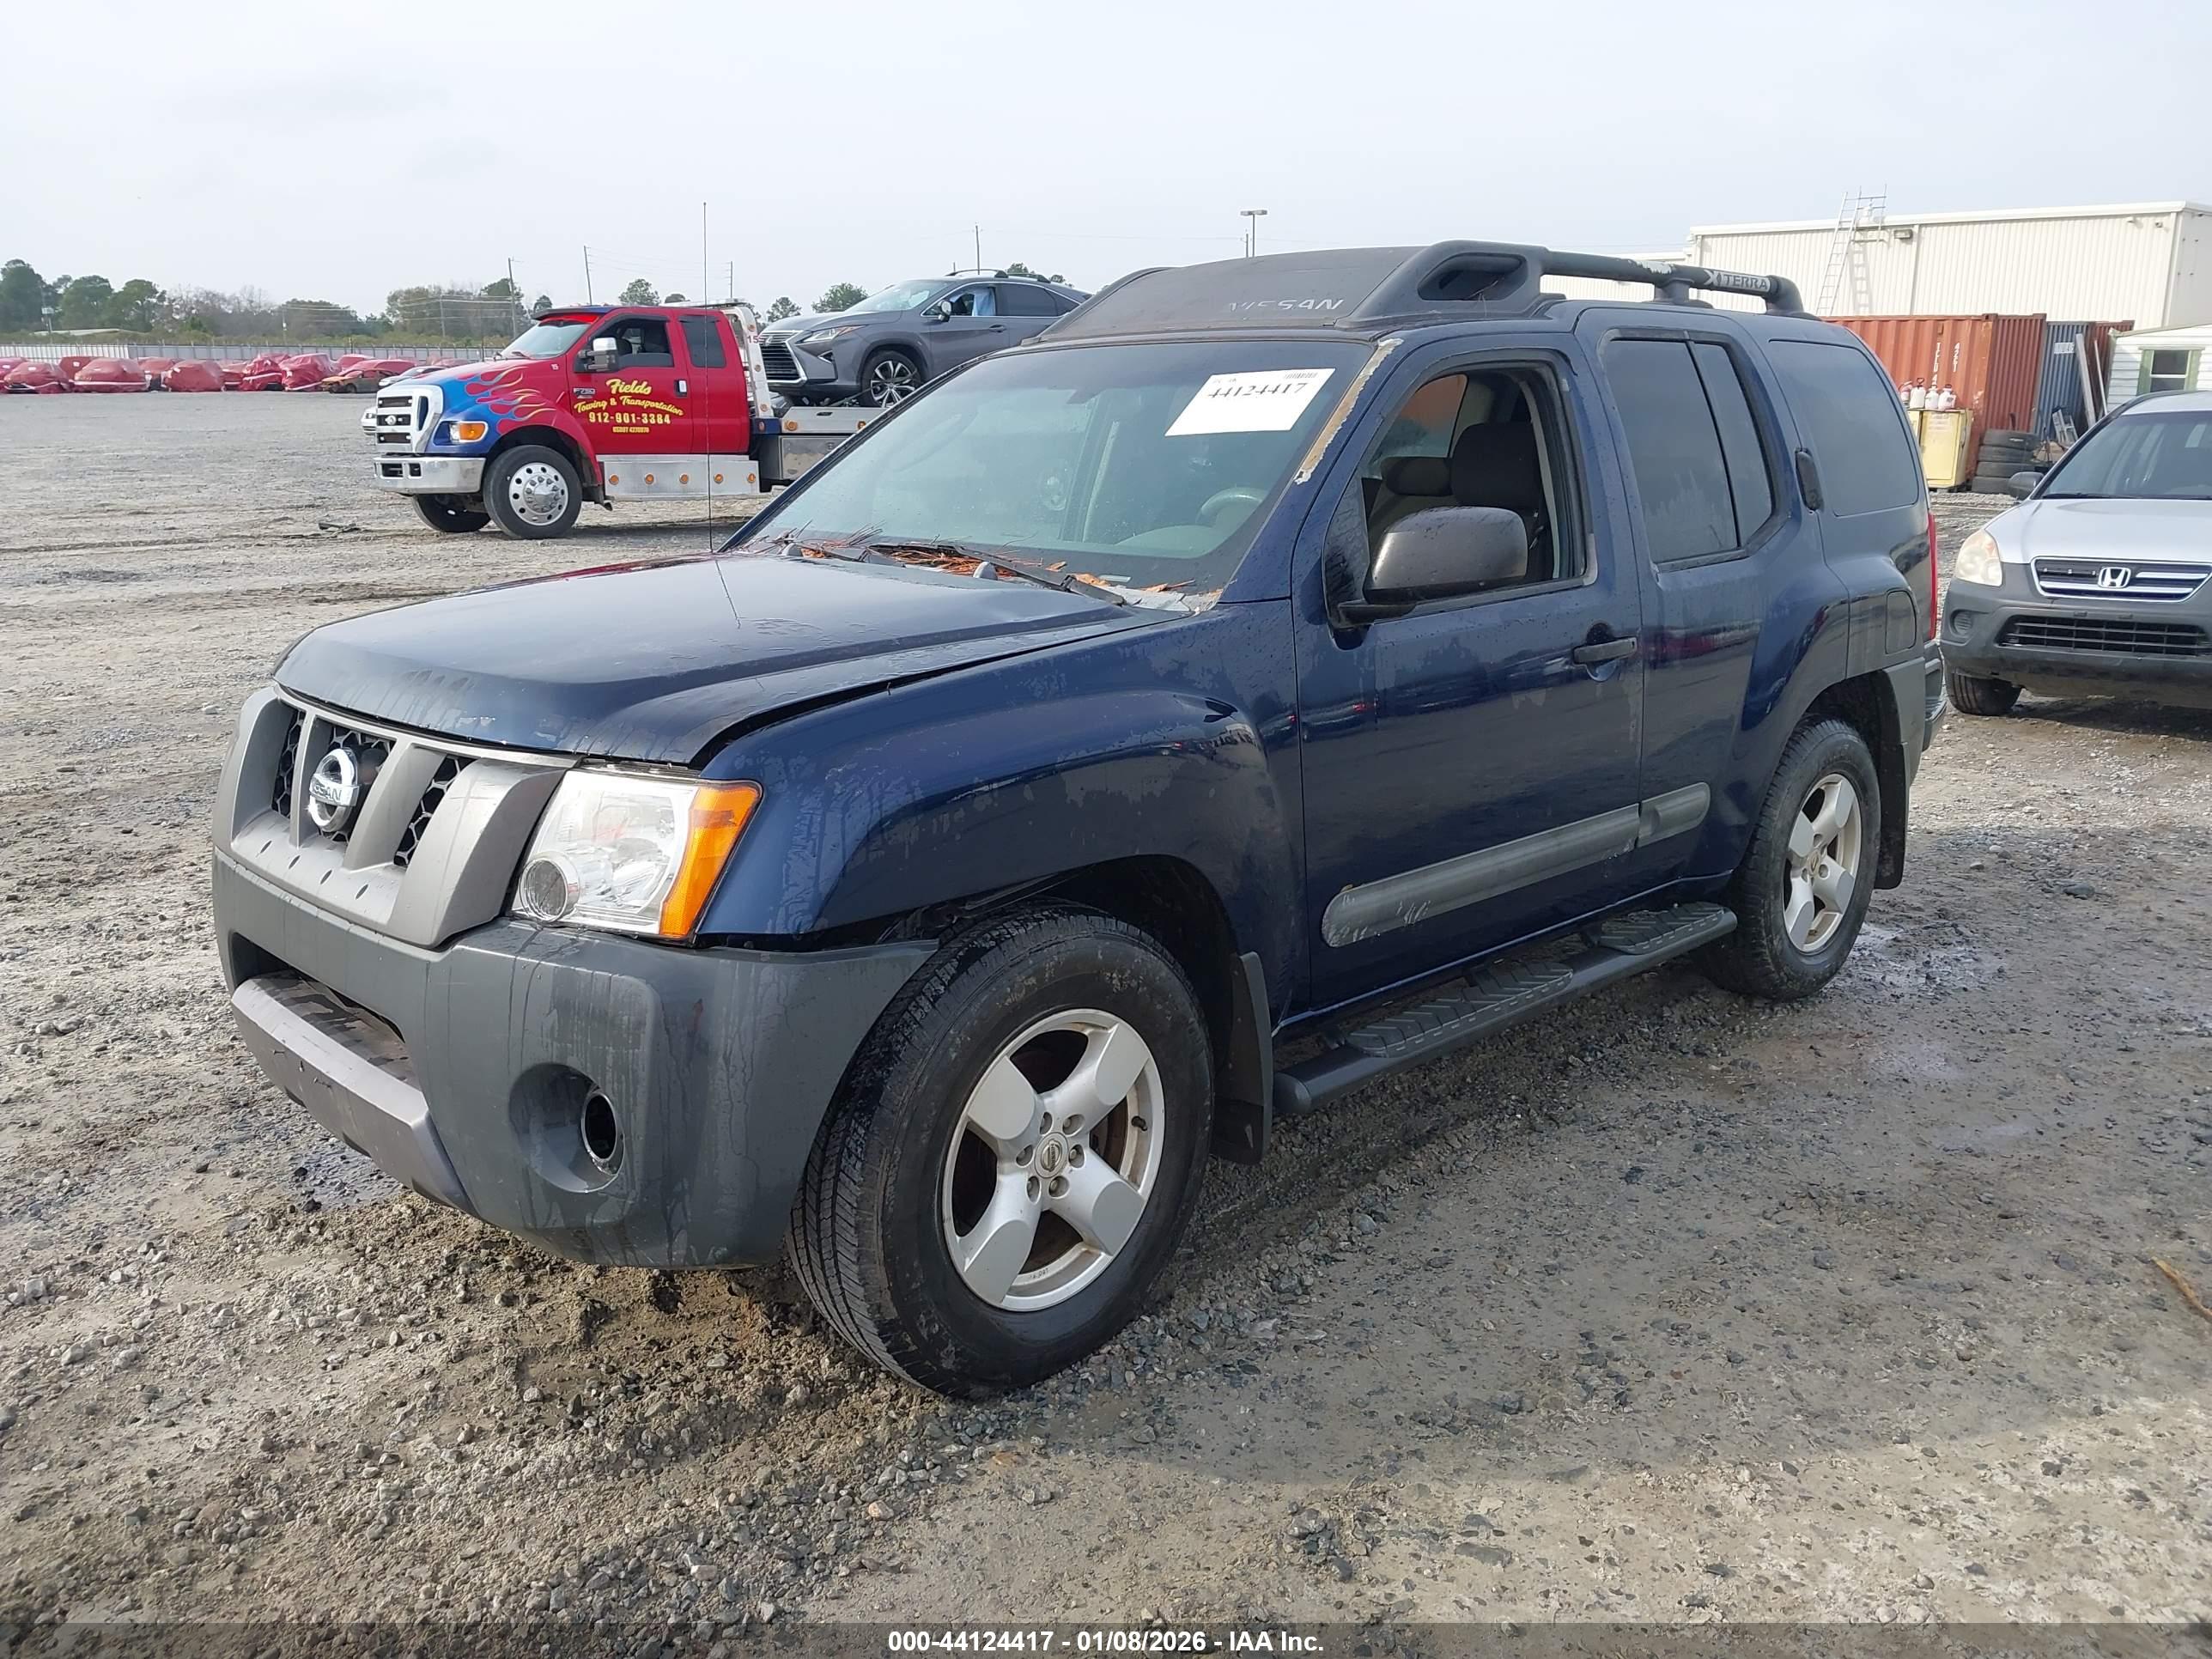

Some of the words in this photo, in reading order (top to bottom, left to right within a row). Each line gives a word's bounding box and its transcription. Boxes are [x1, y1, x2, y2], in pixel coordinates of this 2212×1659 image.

[1704, 269, 1769, 290] XTERRA
[605, 378, 652, 394] Fields
[1208, 383, 1309, 398] 44124417
[574, 400, 608, 413] Towing
[620, 395, 684, 416] Transportation
[588, 412, 671, 424] 912-901-3384
